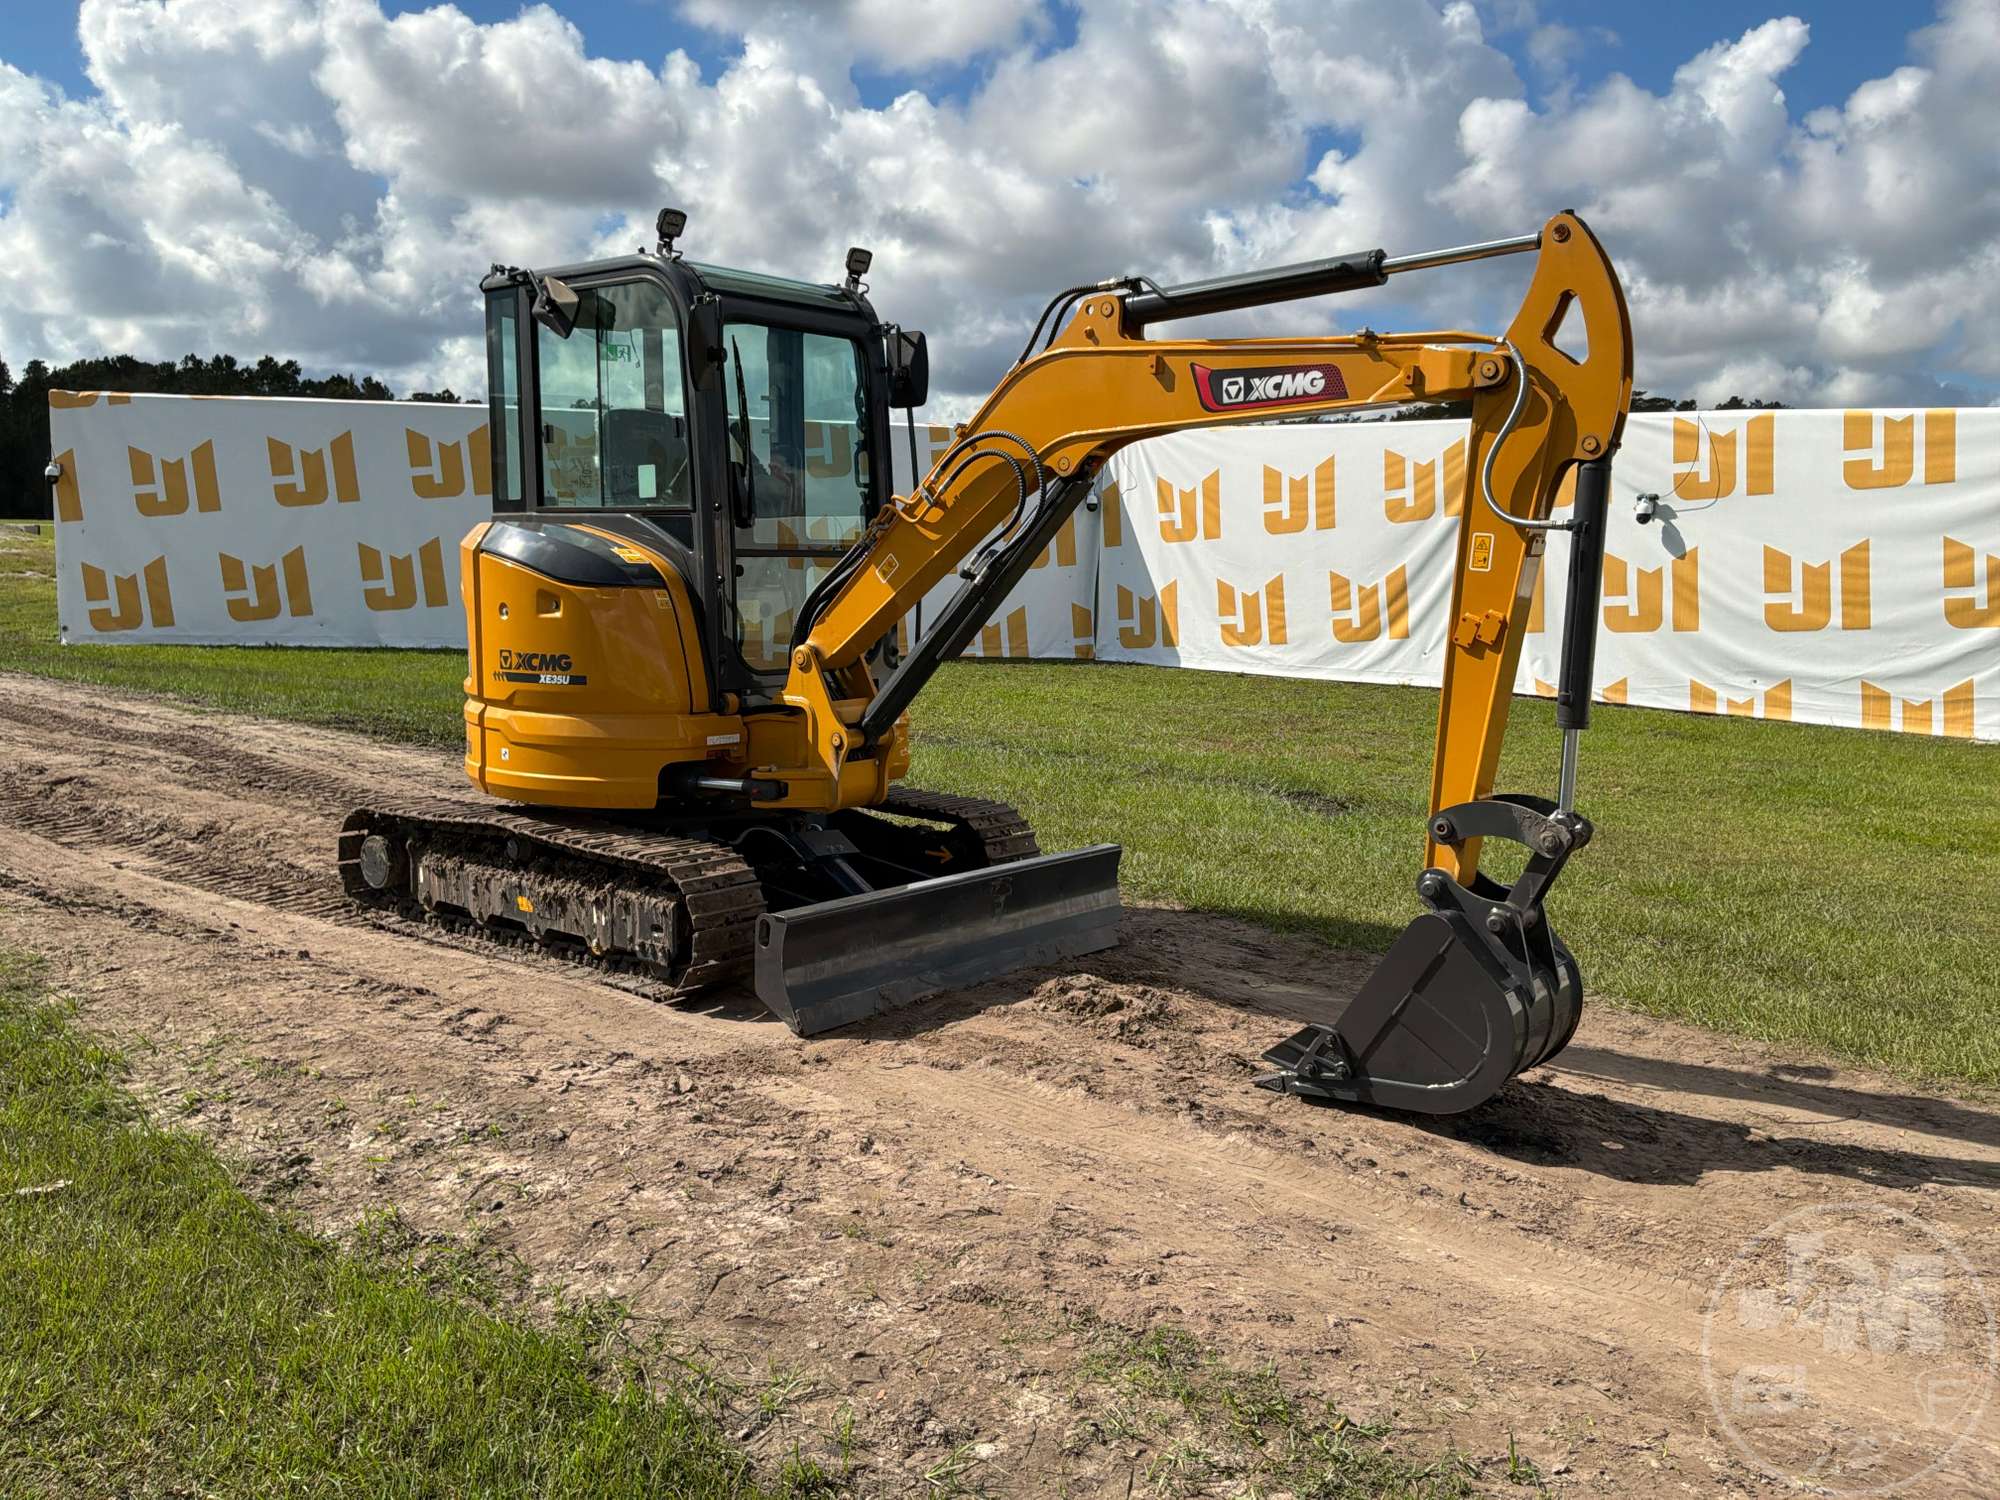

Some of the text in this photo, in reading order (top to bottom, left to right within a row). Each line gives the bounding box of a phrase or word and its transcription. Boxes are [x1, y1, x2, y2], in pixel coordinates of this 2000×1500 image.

[1246, 370, 1326, 401] XCMG
[513, 652, 573, 672] XCMG
[539, 674, 570, 685] XE35U
